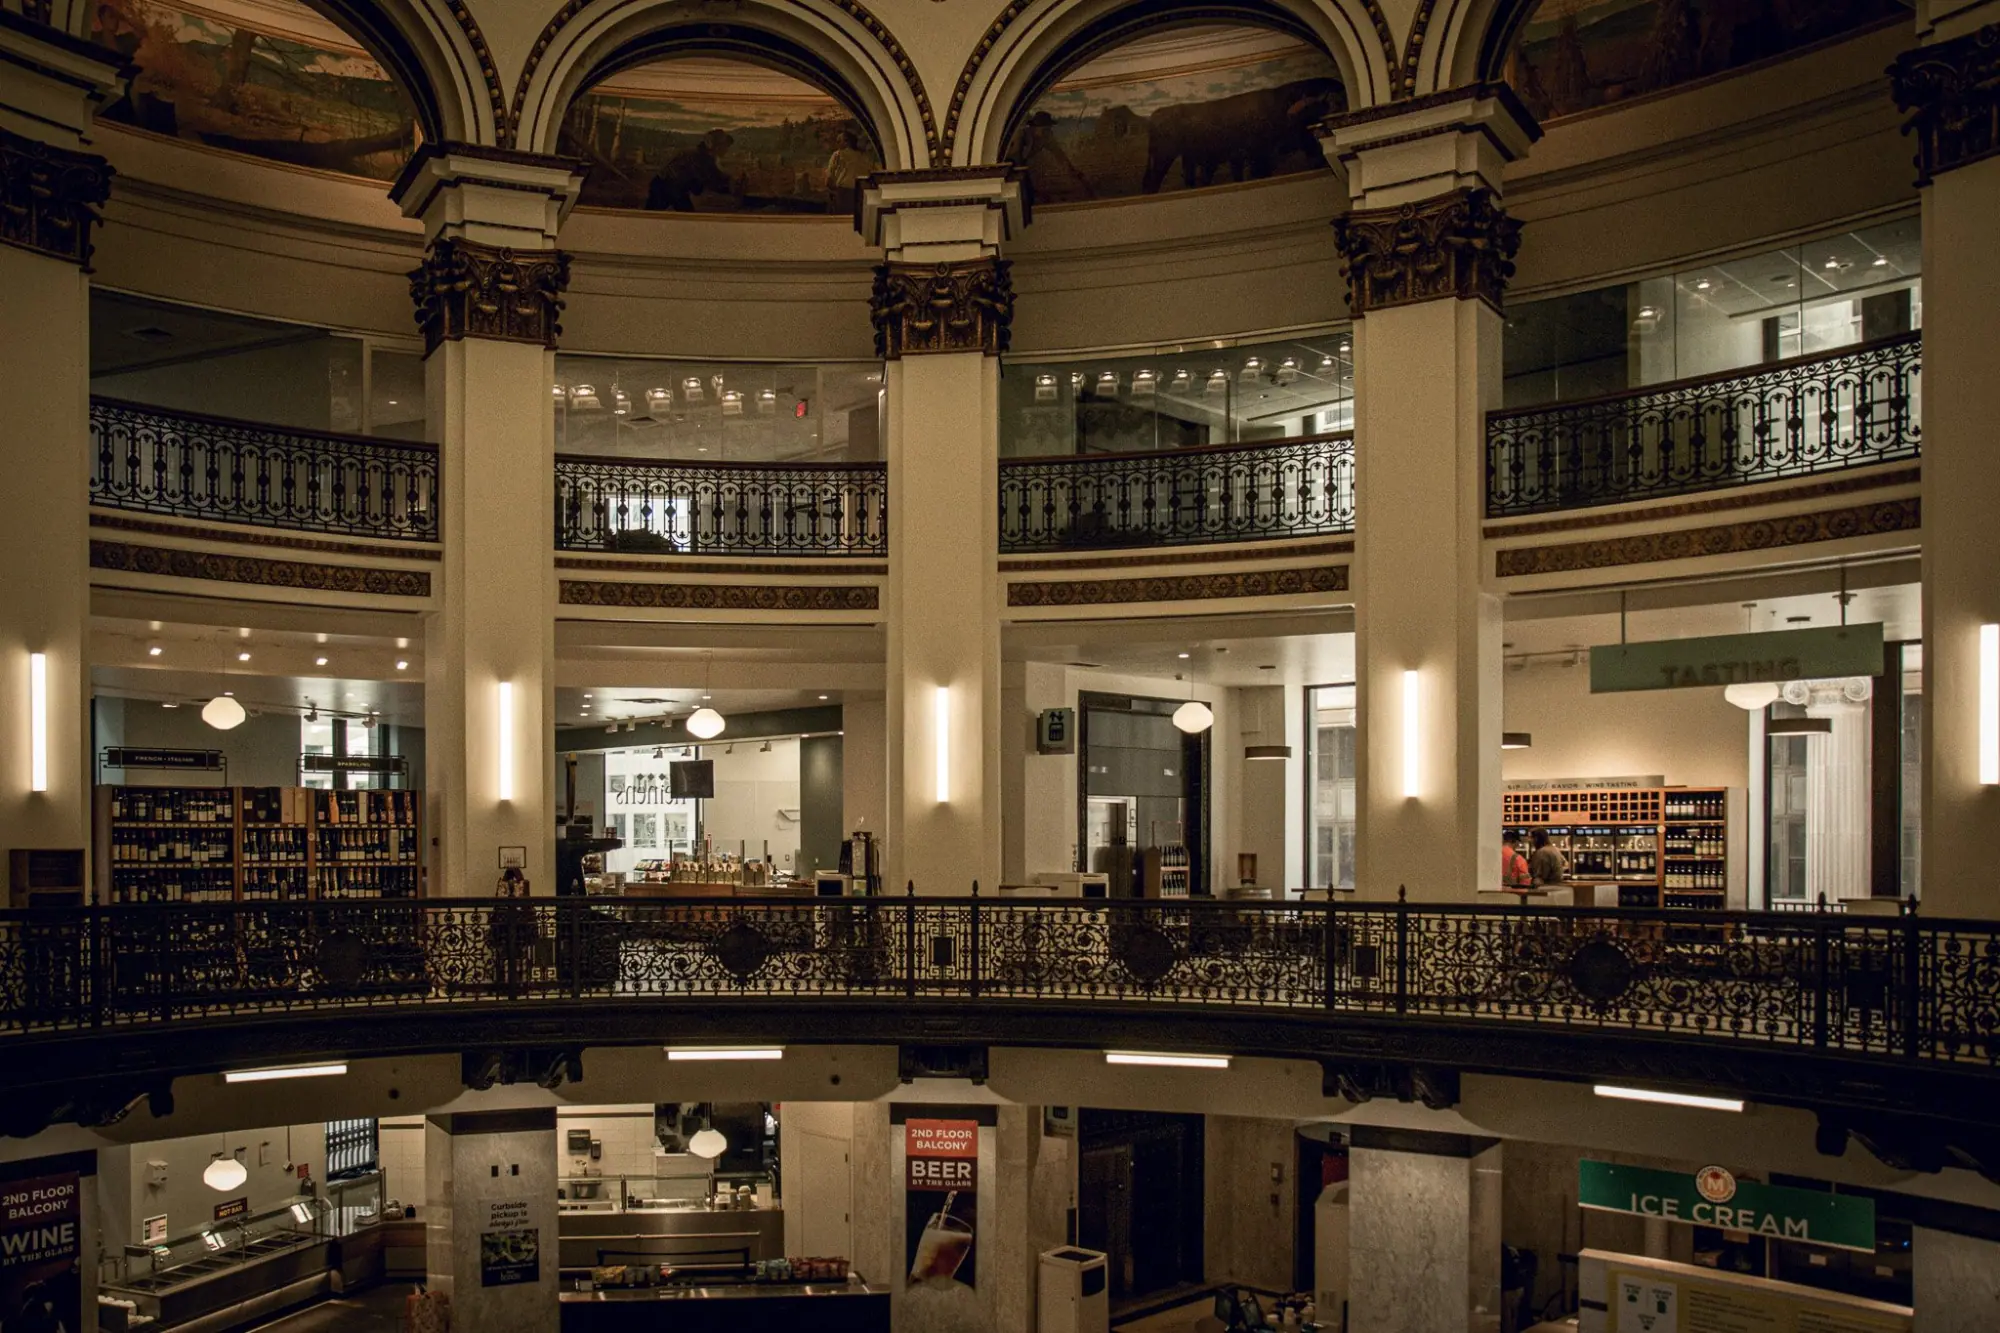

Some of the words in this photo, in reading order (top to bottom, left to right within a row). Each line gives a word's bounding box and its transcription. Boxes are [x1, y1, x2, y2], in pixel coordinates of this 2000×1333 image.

[1661, 657, 1800, 686] TASTING
[911, 1129, 933, 1138] 2ND
[936, 1129, 972, 1139] FLOOR
[916, 1140, 967, 1150] BALCONY
[911, 1160, 972, 1179] BEER
[926, 1179, 943, 1187] THE
[2, 1193, 29, 1207] 2ND
[32, 1185, 74, 1200] FLOOR
[8, 1199, 69, 1219] BALCONY
[491, 1202, 527, 1211] Curbside
[491, 1212, 519, 1220] pickup
[1631, 1192, 1680, 1219] ICE
[1692, 1203, 1809, 1239] CREAM
[0, 1222, 75, 1255] WINE
[3, 1256, 18, 1267] BY
[21, 1251, 42, 1263] THE
[44, 1245, 75, 1259] GLASS
